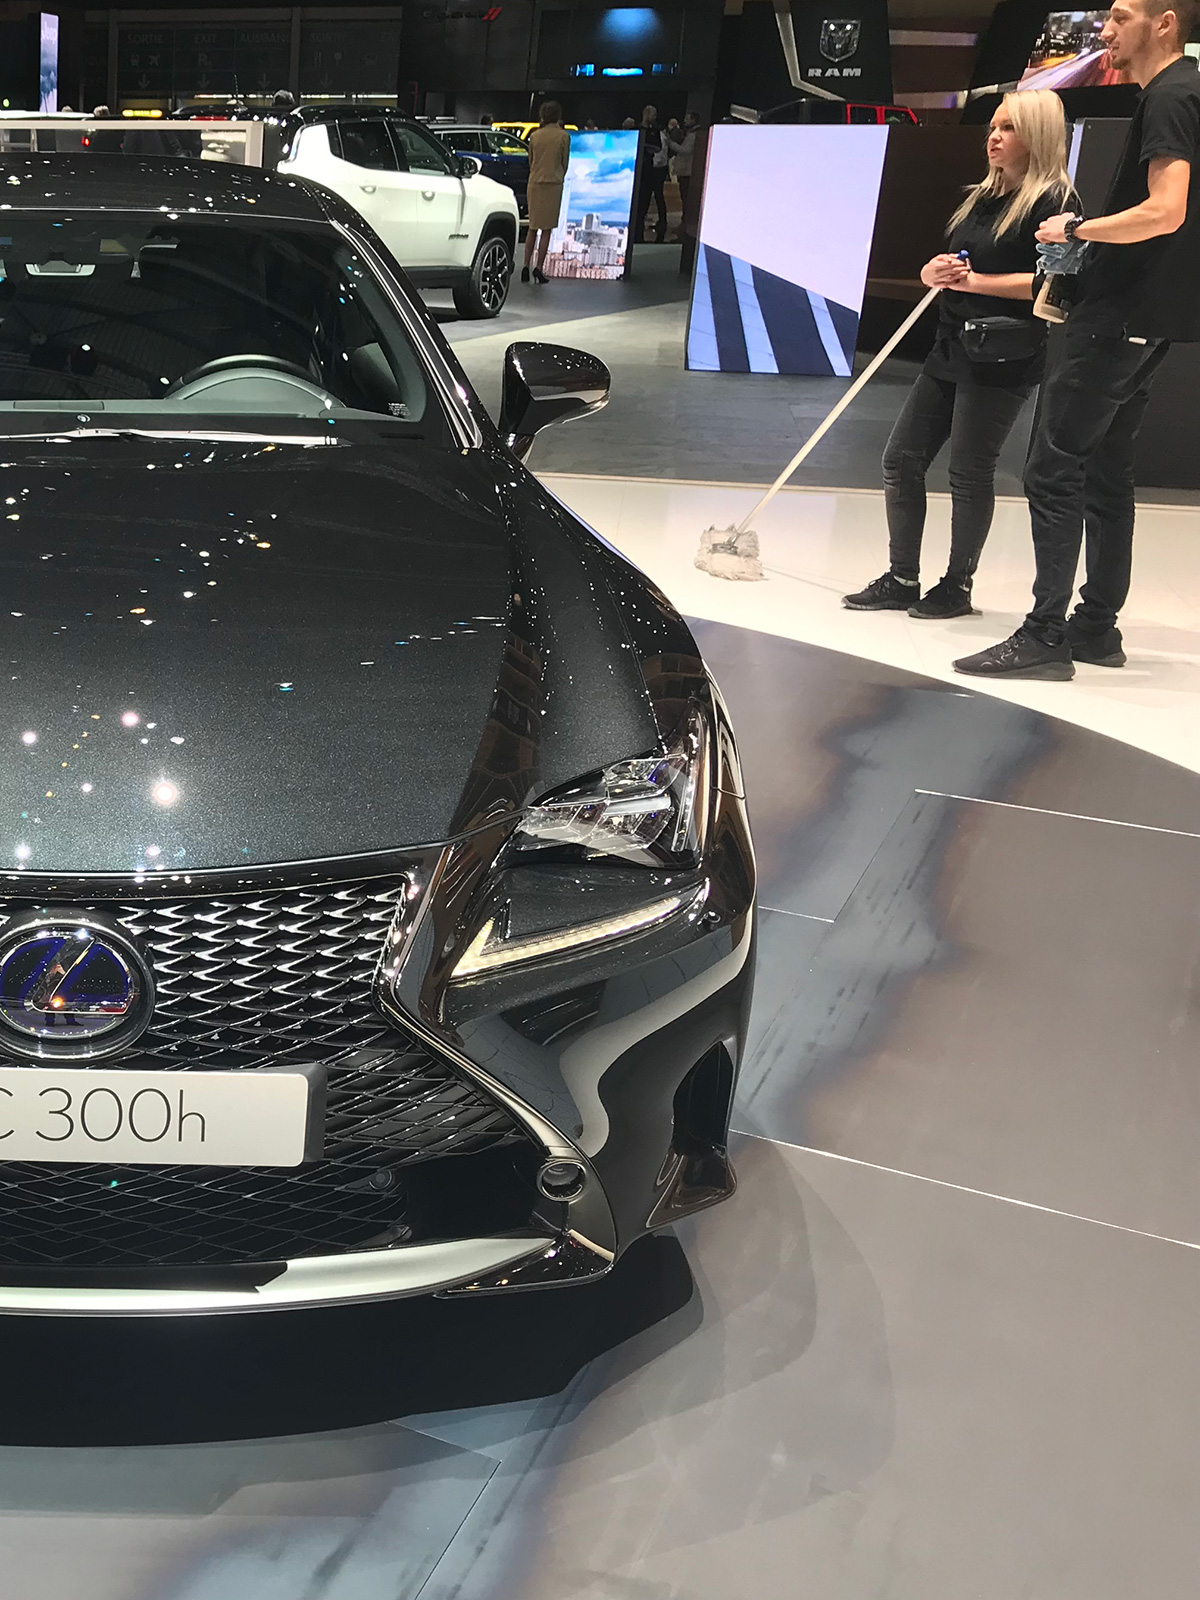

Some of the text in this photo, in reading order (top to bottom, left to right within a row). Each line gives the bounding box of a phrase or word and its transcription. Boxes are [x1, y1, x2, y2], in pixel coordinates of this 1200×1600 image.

[127, 33, 163, 44] SORTIE
[194, 33, 217, 43] EXIT
[807, 67, 862, 77] RAM
[35, 1087, 206, 1143] 300h
